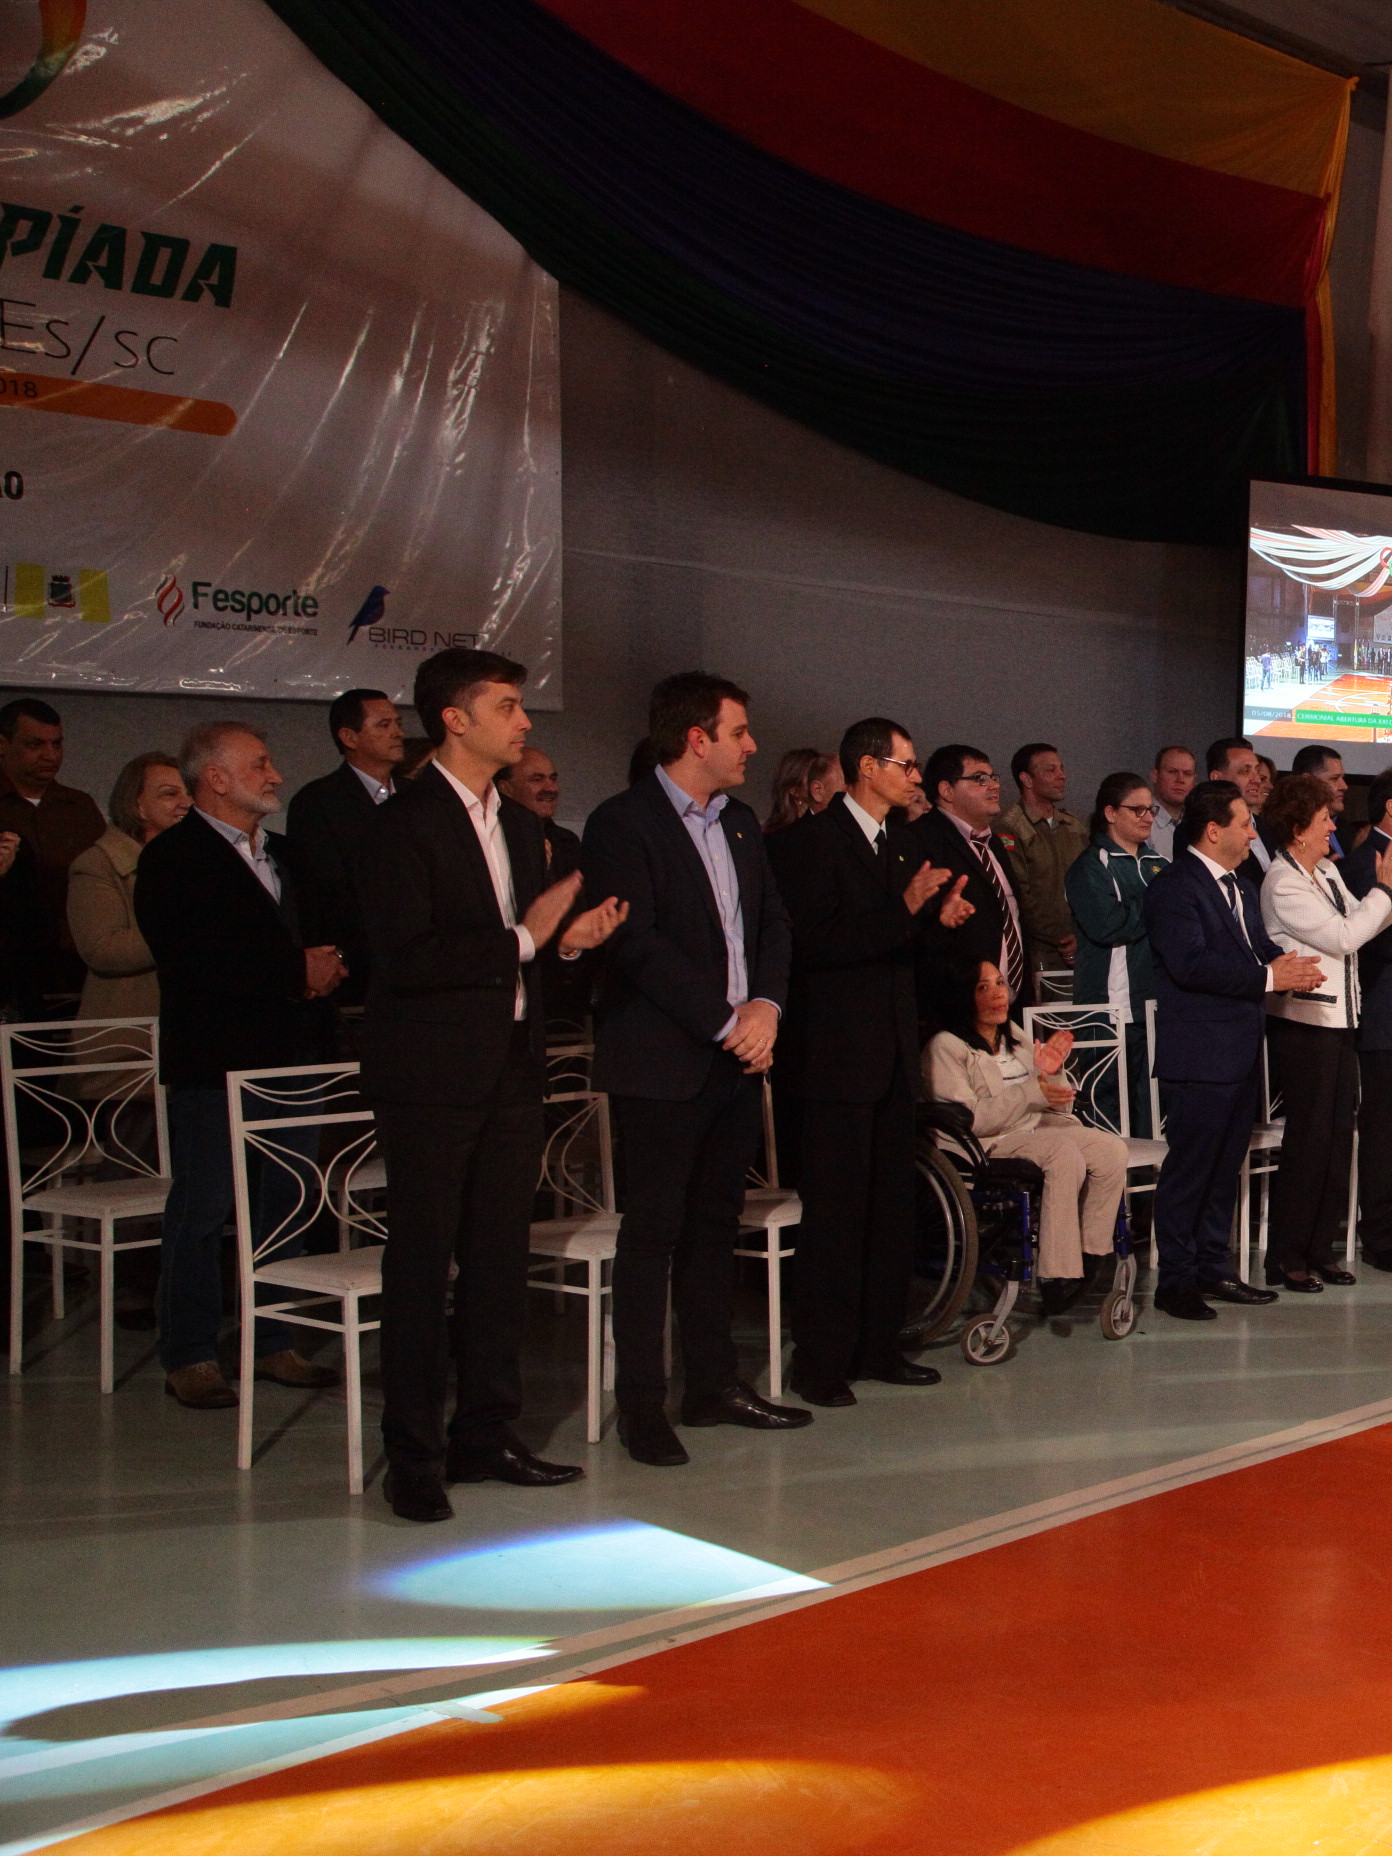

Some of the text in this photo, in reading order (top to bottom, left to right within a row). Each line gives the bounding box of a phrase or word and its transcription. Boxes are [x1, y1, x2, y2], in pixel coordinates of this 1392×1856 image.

[0, 470, 24, 500] O
[192, 581, 319, 621] Fesporte
[368, 627, 483, 649] BIRD NET
[1297, 713, 1334, 722] CERIMONIAL
[1336, 715, 1367, 724] ABERTURA
